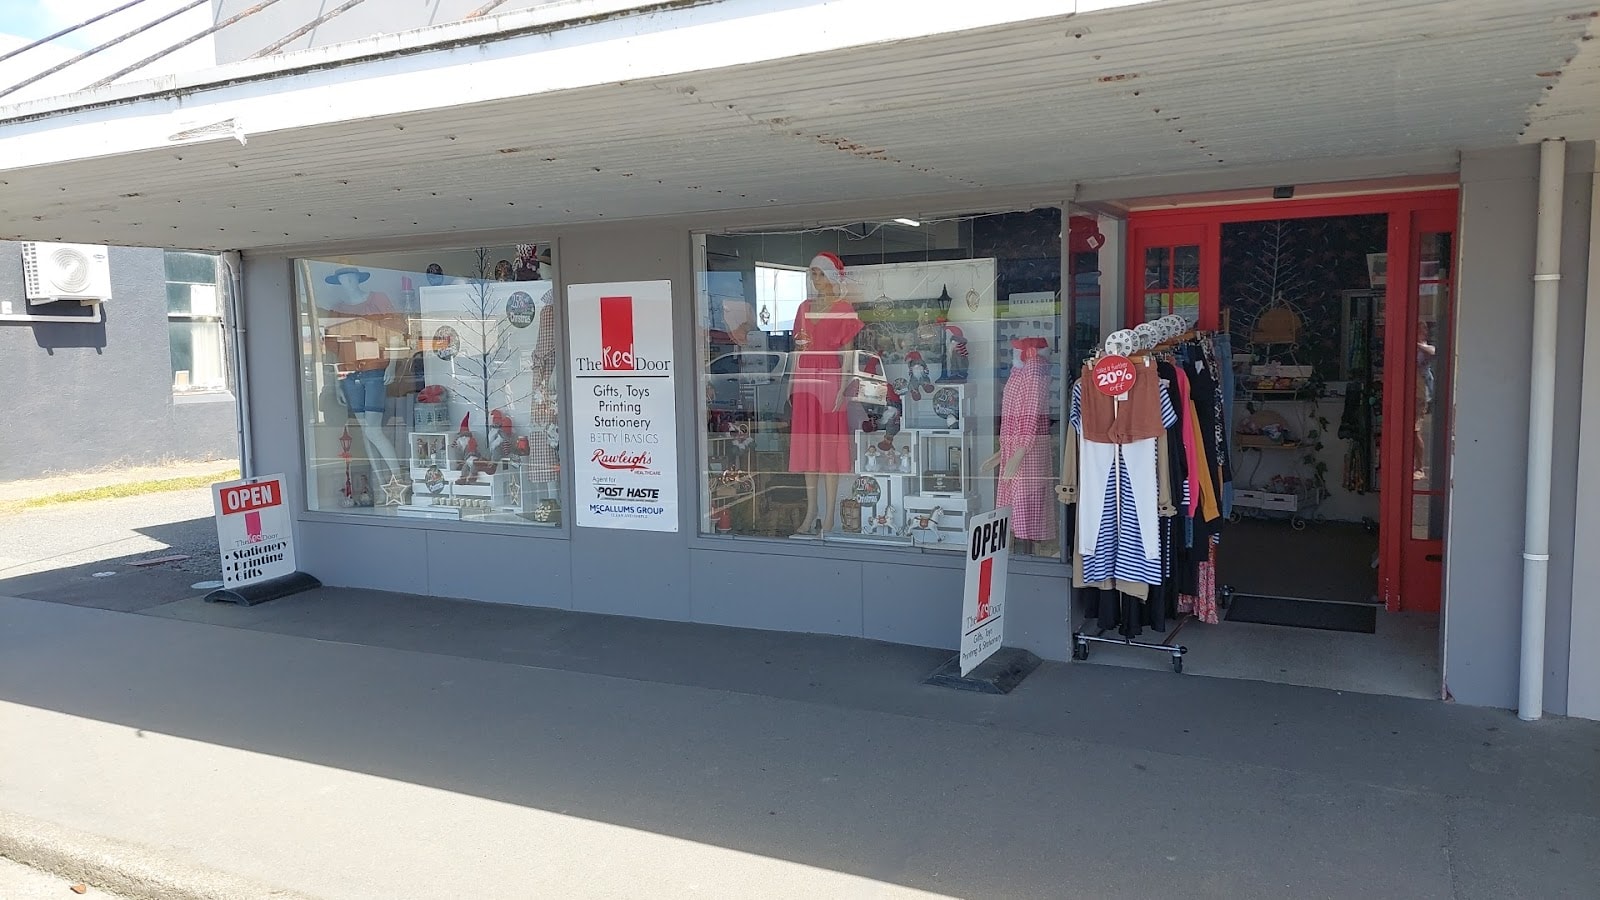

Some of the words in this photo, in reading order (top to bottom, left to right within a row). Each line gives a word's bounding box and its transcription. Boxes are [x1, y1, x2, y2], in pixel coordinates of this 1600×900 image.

[576, 357, 602, 371] The
[603, 343, 634, 368] Red
[635, 357, 671, 371] Door
[1097, 368, 1133, 387] 20%
[593, 384, 622, 398] Gifts,
[626, 384, 650, 399] Toys
[1110, 382, 1125, 391] off
[599, 400, 641, 415] Printing
[594, 415, 651, 431] Stationery
[590, 432, 618, 443] BETTY
[624, 433, 659, 444] BASICS
[592, 476, 608, 484] Agent
[227, 484, 273, 511] OPEN
[597, 486, 624, 498] POST
[627, 487, 659, 499] HASTE
[636, 506, 664, 515] GROUP
[971, 516, 1008, 561] OPEN
[233, 541, 288, 560] Stationery
[234, 552, 283, 572] Printing
[236, 567, 263, 582] Gifts
